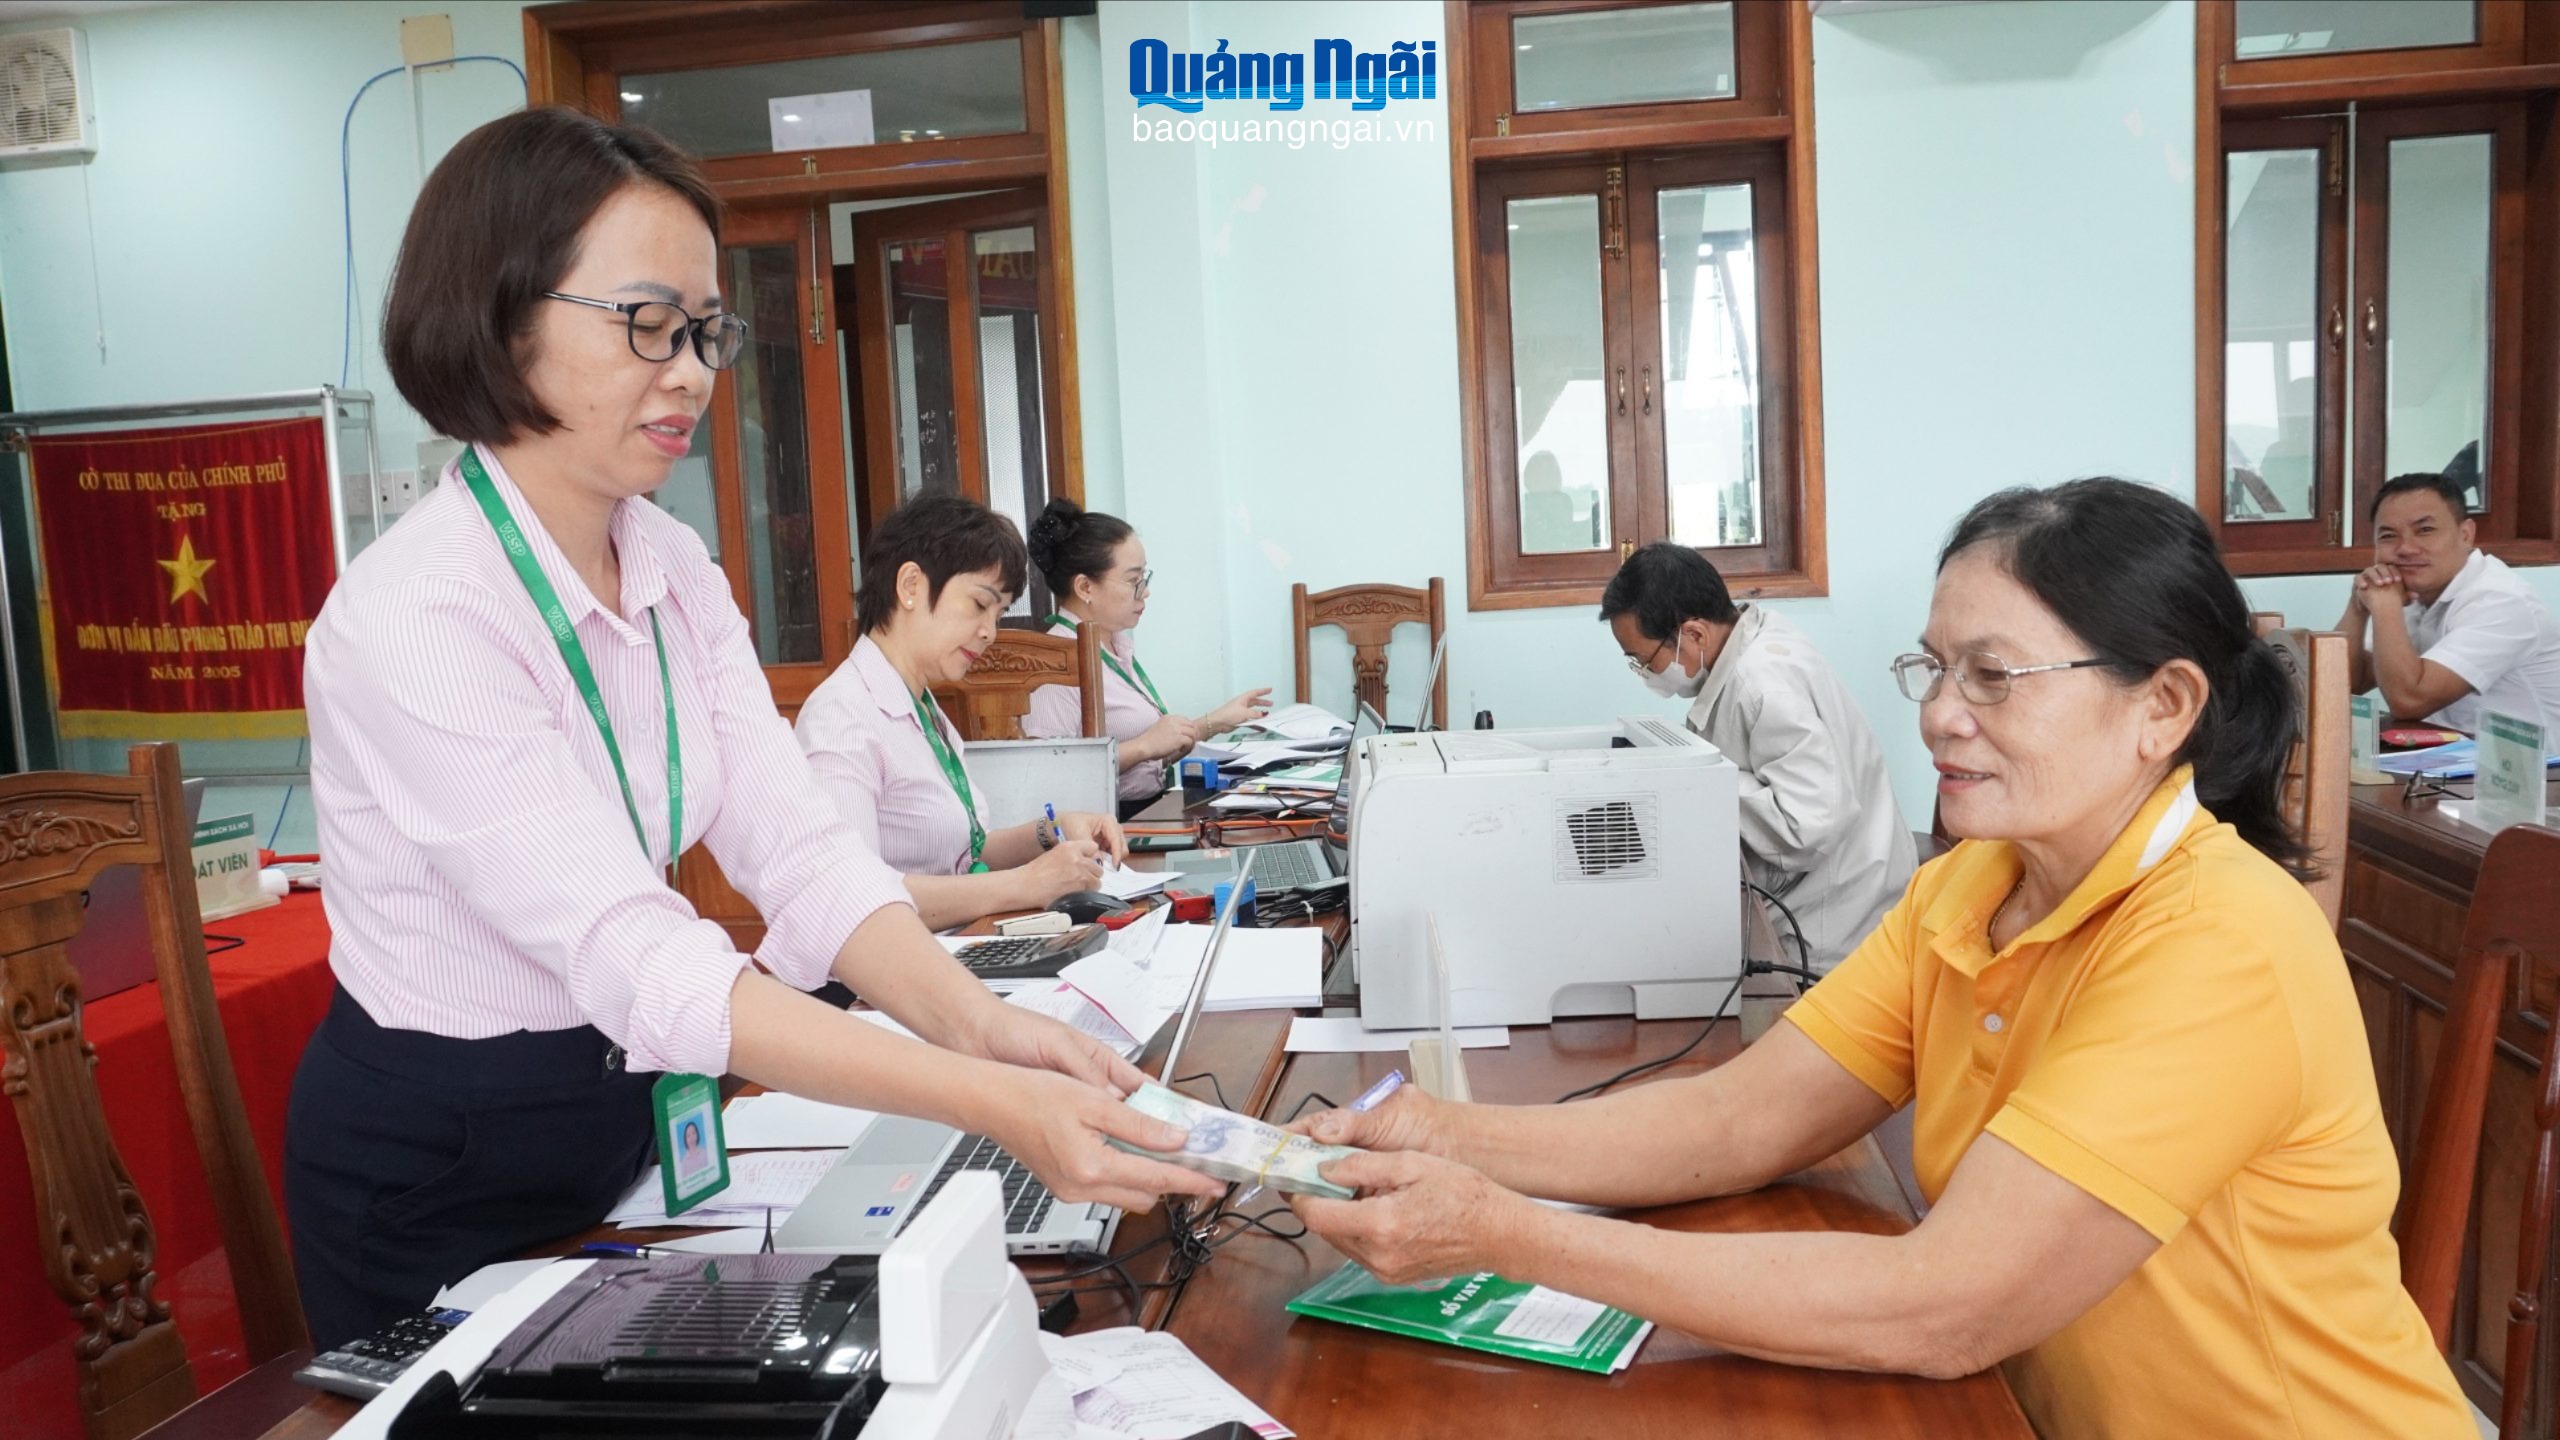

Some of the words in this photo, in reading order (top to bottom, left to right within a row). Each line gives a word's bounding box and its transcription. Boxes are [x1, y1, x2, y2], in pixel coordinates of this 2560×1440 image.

[79, 466, 100, 490] CỜ
[103, 472, 131, 490] THI
[136, 472, 165, 491] ĐUA
[168, 464, 199, 489] CỦA
[203, 462, 252, 486] CHÍNH
[256, 455, 286, 483] PHỦ
[157, 502, 206, 522] TẶNG
[499, 520, 526, 556] VBSP
[107, 625, 123, 654] VỊ
[181, 626, 226, 652] PHONG
[228, 620, 265, 650] TRÀO
[266, 622, 290, 648] THI
[290, 619, 312, 646] ĐU
[547, 605, 573, 641] VBSP
[150, 663, 195, 680] NĂM
[203, 665, 241, 680] 2005
[218, 852, 248, 875] VIÊN
[1453, 1281, 1481, 1301] VAY
